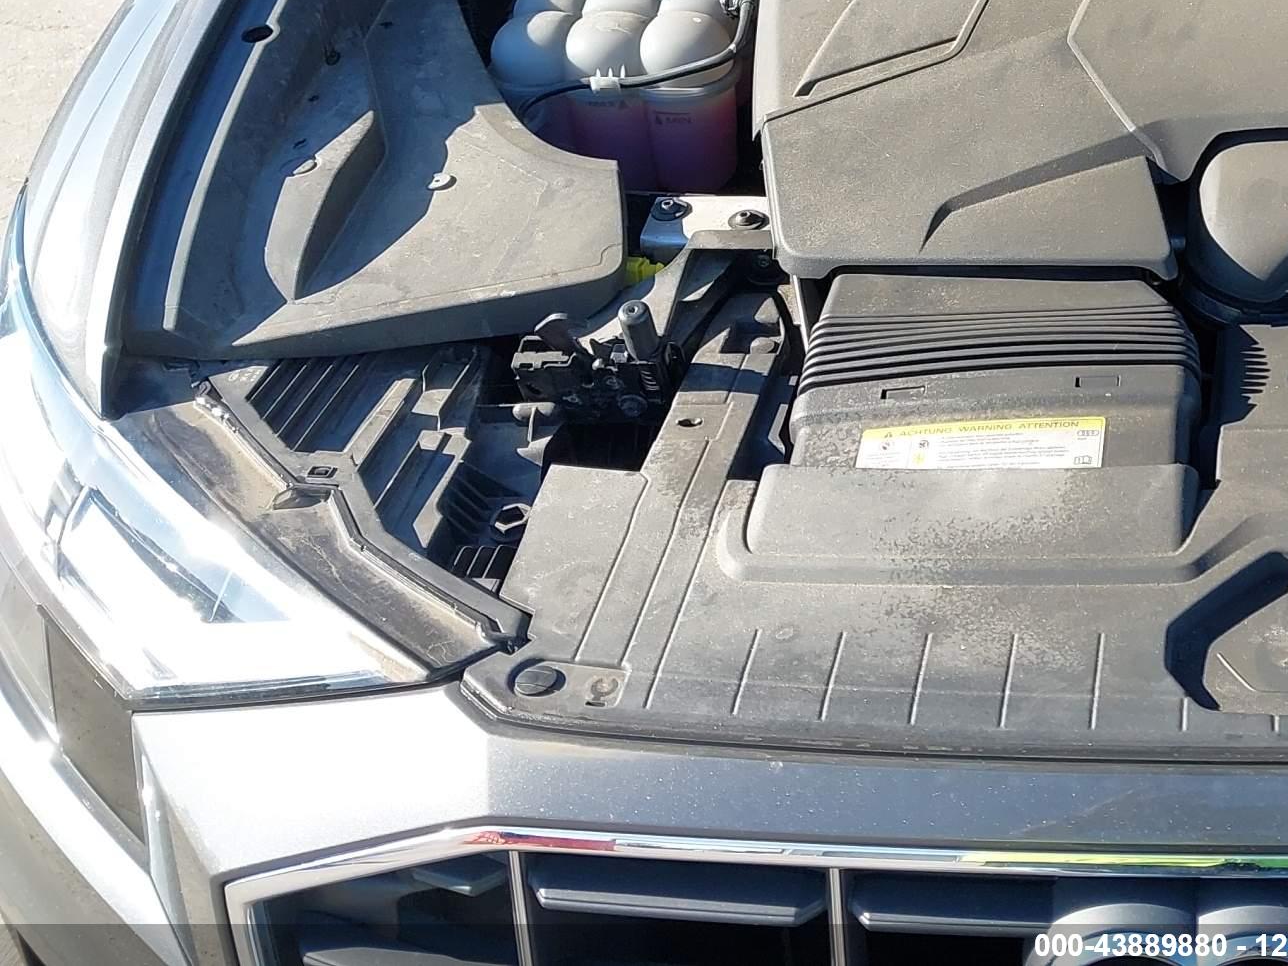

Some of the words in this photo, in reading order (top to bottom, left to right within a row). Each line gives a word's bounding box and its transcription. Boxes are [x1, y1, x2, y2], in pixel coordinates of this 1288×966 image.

[899, 427, 952, 436] ACHTUNG
[959, 424, 1012, 433] WARNING
[1018, 421, 1080, 429] ATTENTION
